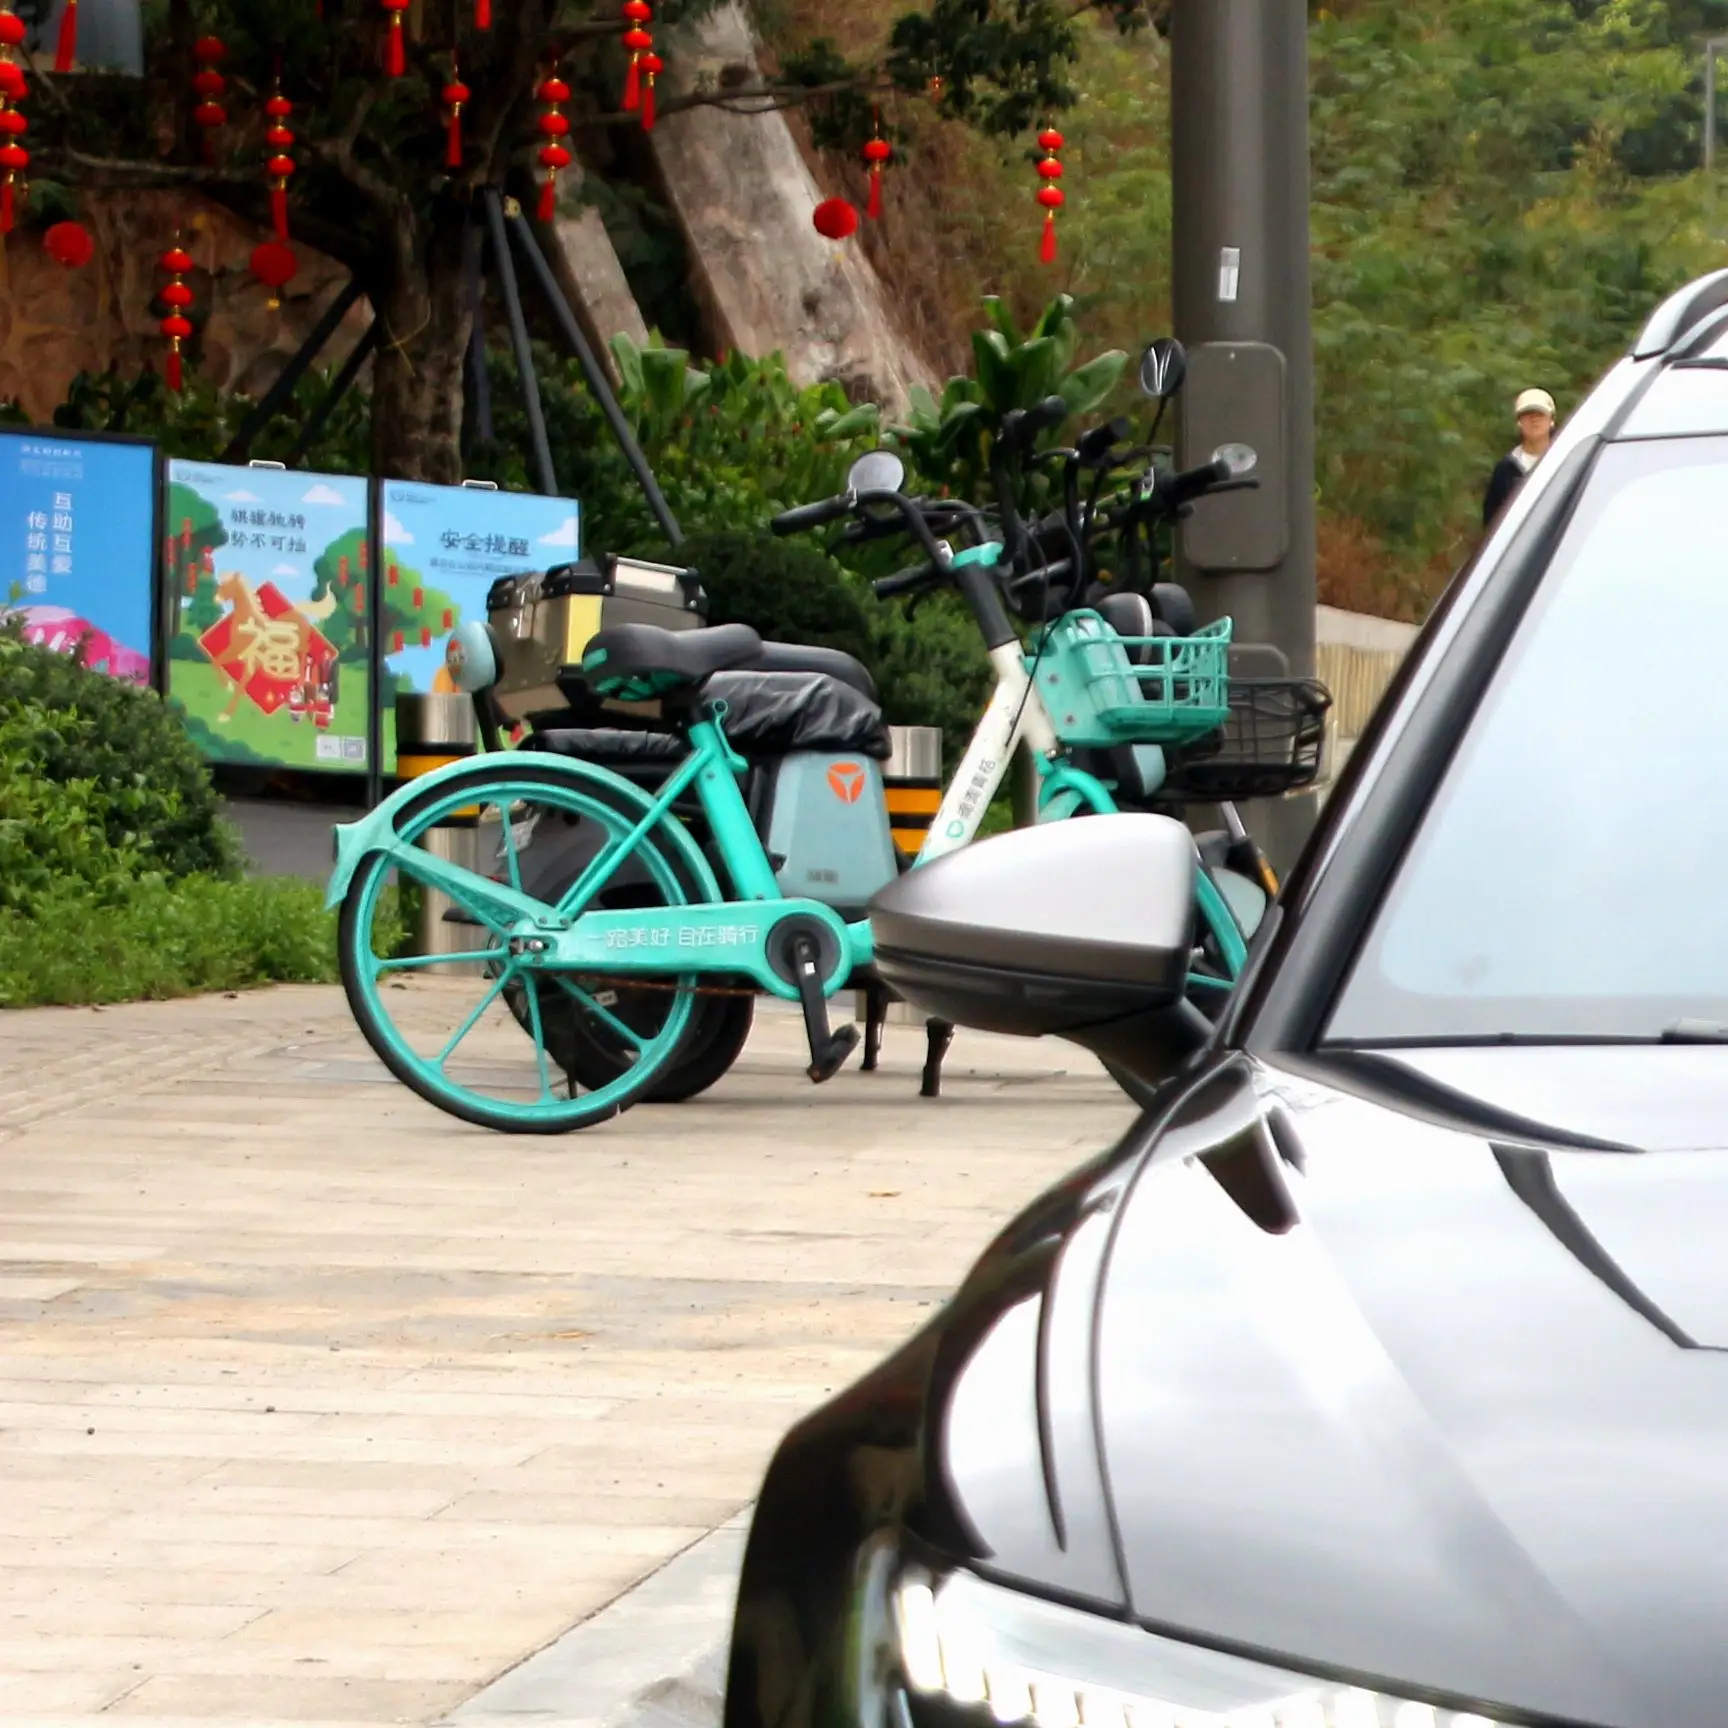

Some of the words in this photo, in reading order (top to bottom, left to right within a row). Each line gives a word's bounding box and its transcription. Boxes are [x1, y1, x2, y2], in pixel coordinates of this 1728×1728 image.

[440, 528, 531, 556] 安全提醒
[238, 617, 300, 679] 福
[678, 925, 758, 947] 自在骑行
